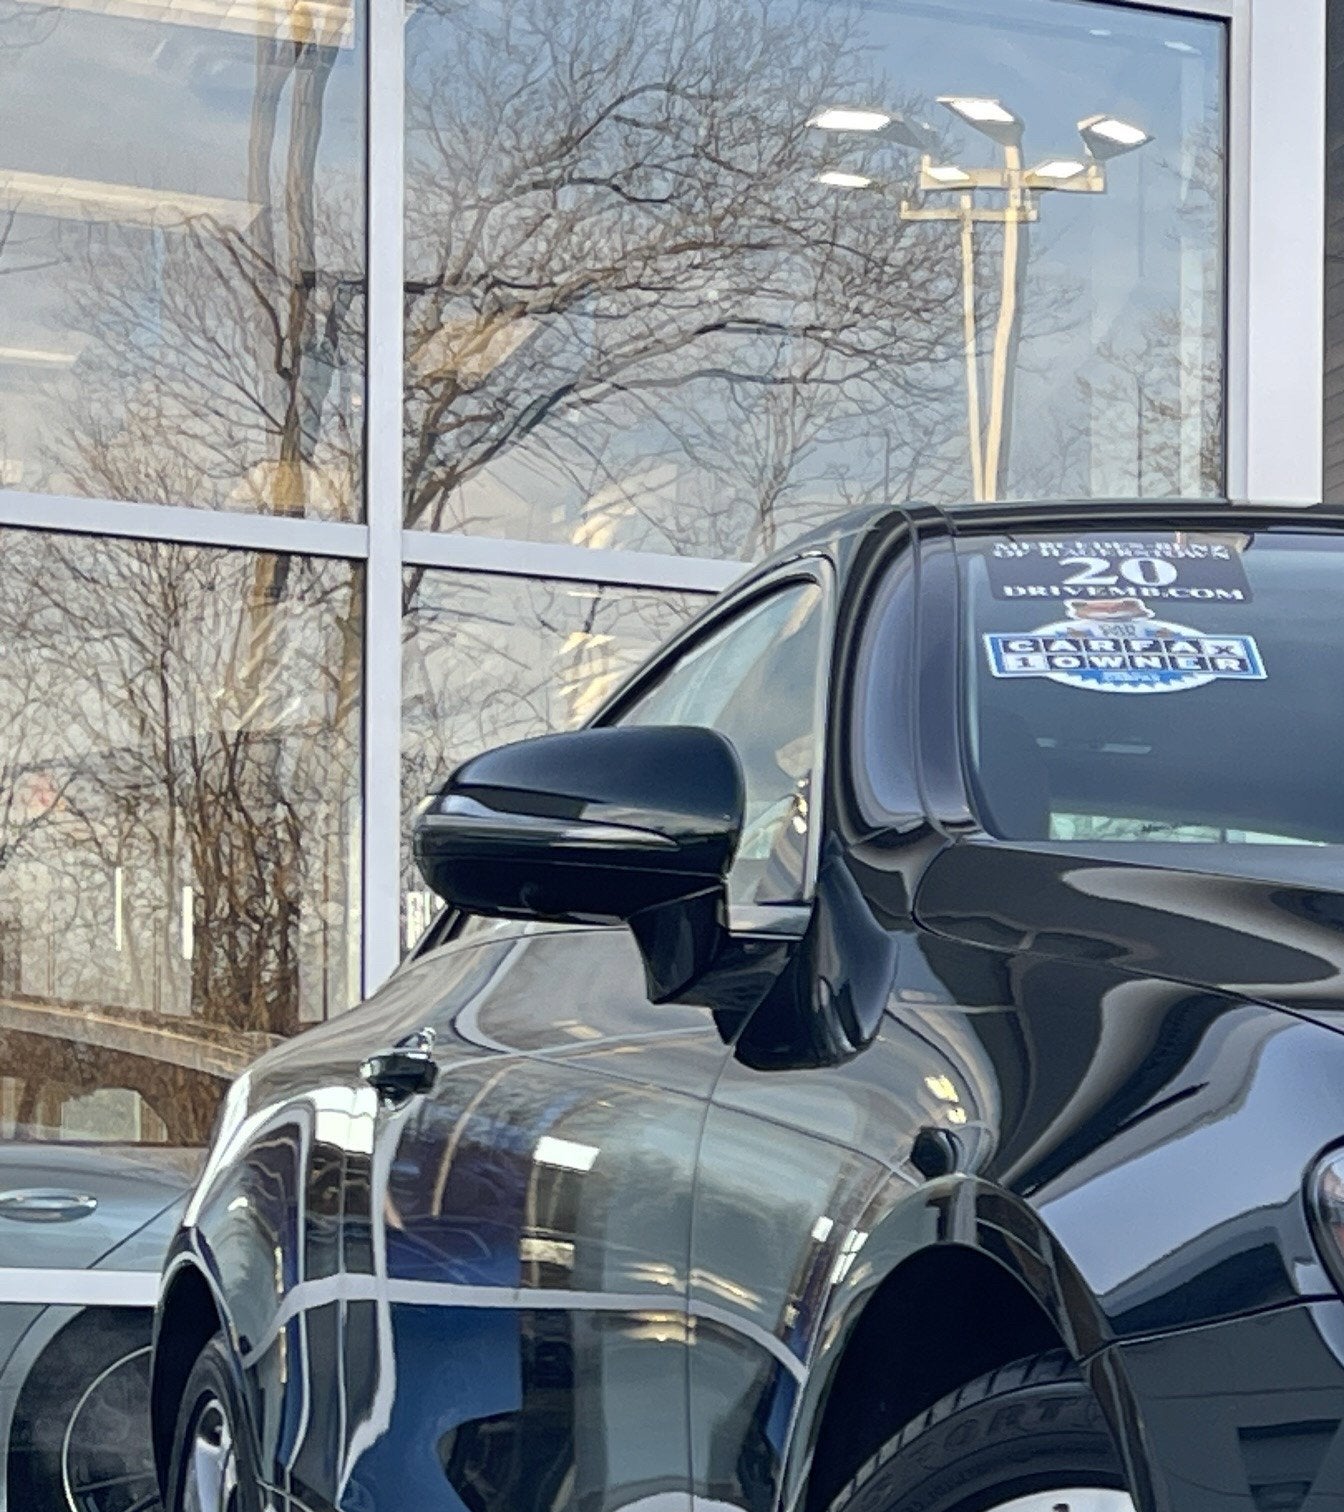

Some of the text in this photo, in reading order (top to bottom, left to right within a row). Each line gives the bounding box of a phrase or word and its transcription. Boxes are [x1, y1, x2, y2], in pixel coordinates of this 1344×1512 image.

[1057, 556, 1178, 587] 20
[1003, 584, 1245, 601] DRIVEMB.COM
[1008, 638, 1238, 656] CARFAX
[1053, 655, 1243, 671] OWNER
